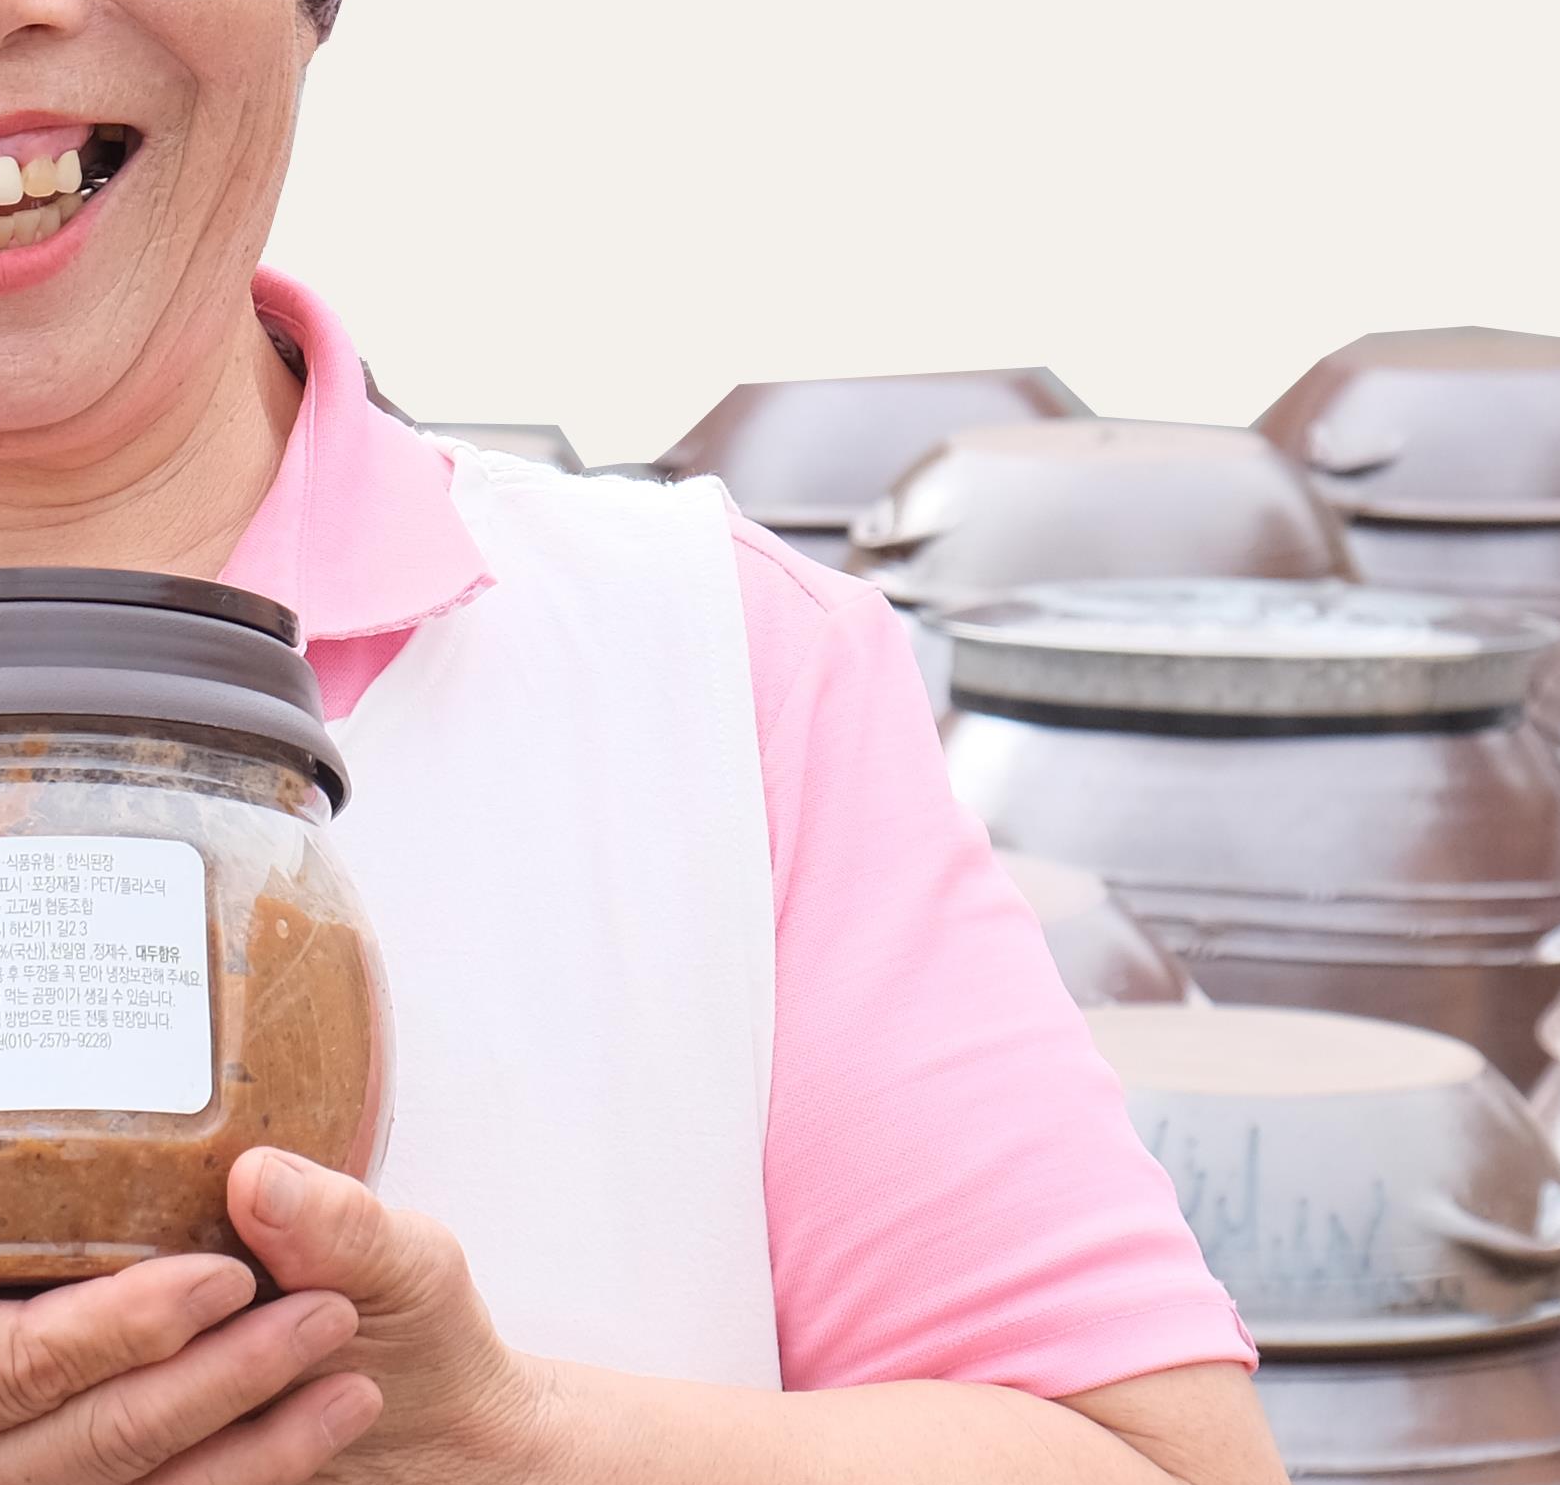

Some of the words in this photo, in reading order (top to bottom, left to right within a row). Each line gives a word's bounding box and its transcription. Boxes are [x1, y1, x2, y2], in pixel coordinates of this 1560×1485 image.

[66, 853, 114, 872] 한식된장
[91, 876, 167, 897] PET/플라스틱
[46, 896, 94, 916] 협동조합
[135, 944, 181, 964] 대두함유
[7, 965, 18, 983] 후
[23, 964, 60, 983] 뚜껑을
[62, 965, 76, 982] 꼭
[79, 965, 103, 983] 닫아
[106, 965, 165, 986] 냉장보관해
[4, 987, 29, 1006] 먹는
[32, 986, 81, 1006] 곰팡이가
[84, 987, 109, 1006] 생길
[112, 989, 123, 1005] 수
[5, 1009, 54, 1029] 방법으로
[57, 1009, 81, 1027] 만든
[86, 1010, 108, 1028] 전통
